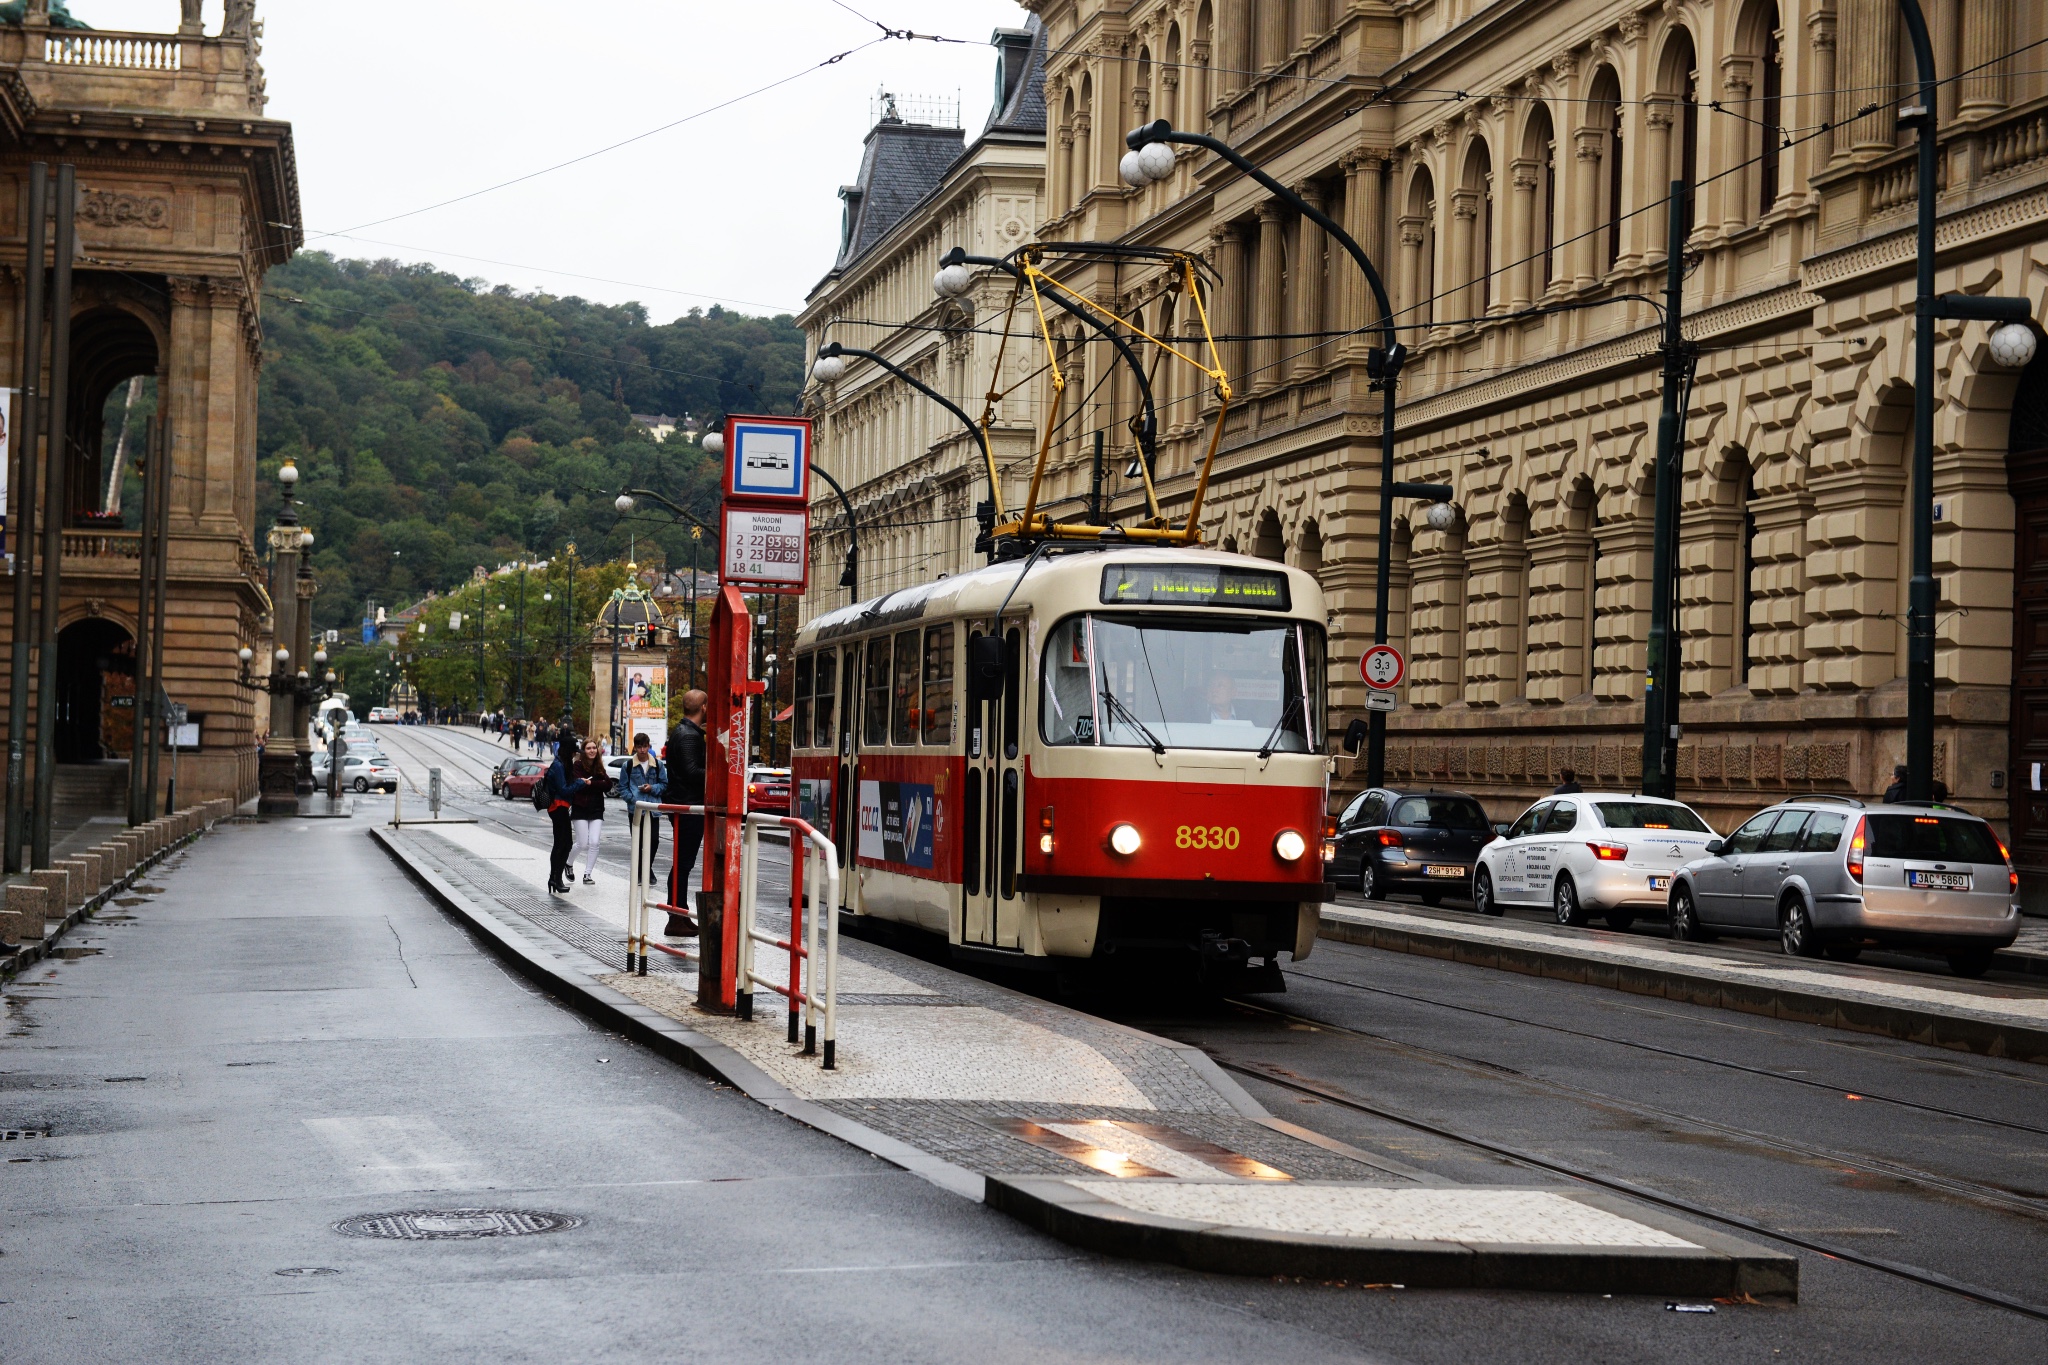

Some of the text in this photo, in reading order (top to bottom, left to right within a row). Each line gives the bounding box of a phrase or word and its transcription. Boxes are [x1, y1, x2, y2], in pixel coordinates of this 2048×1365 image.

[752, 516, 782, 525] NÁRODNÍ
[752, 525, 781, 533] DIVADLO
[736, 534, 799, 548] 2 22 93 98
[736, 548, 799, 562] 9 23 97 99
[732, 562, 763, 574] 18 41
[1117, 570, 1139, 599] 2
[1375, 658, 1390, 670] 3,3
[1078, 719, 1094, 736] 705
[1175, 825, 1240, 850] 8330
[1918, 873, 1964, 886] 3AC 5860
